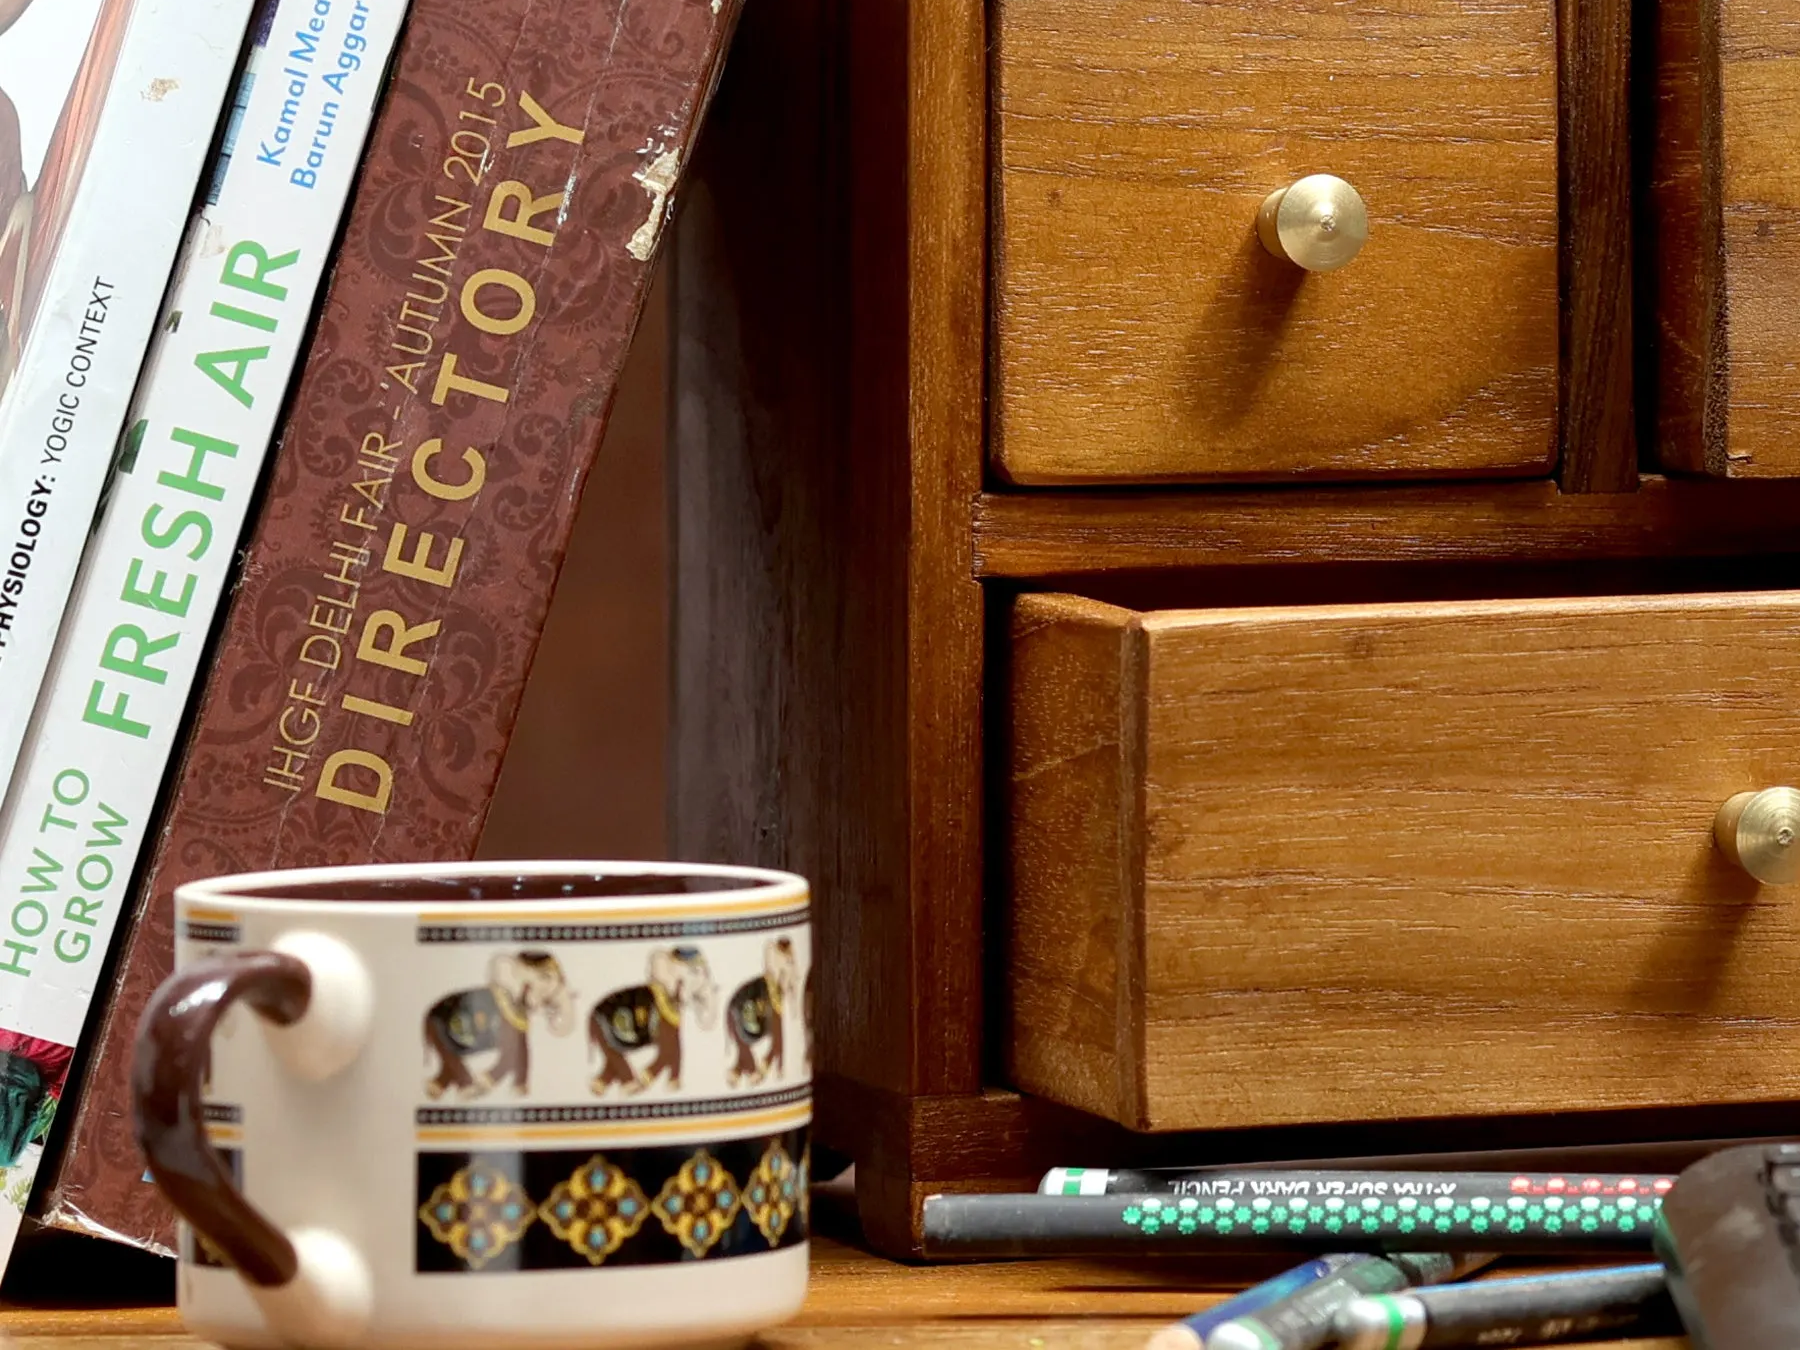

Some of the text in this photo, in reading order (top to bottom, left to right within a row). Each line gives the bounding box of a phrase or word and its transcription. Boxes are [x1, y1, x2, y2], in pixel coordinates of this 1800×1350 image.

[256, 67, 309, 167] Kamal
[289, 101, 340, 190] Barun
[0, 275, 116, 647] HYSIOLOGY: YOGIC CONTEXT
[82, 240, 301, 740] FRESH AIR
[263, 678, 327, 792] IHGF
[300, 541, 370, 671] DELHI
[340, 431, 403, 531] FAIR
[443, 76, 505, 187] 2015
[315, 90, 585, 814] DIRECTORY
[0, 768, 90, 978] HOW TO
[53, 801, 129, 964] GROW
